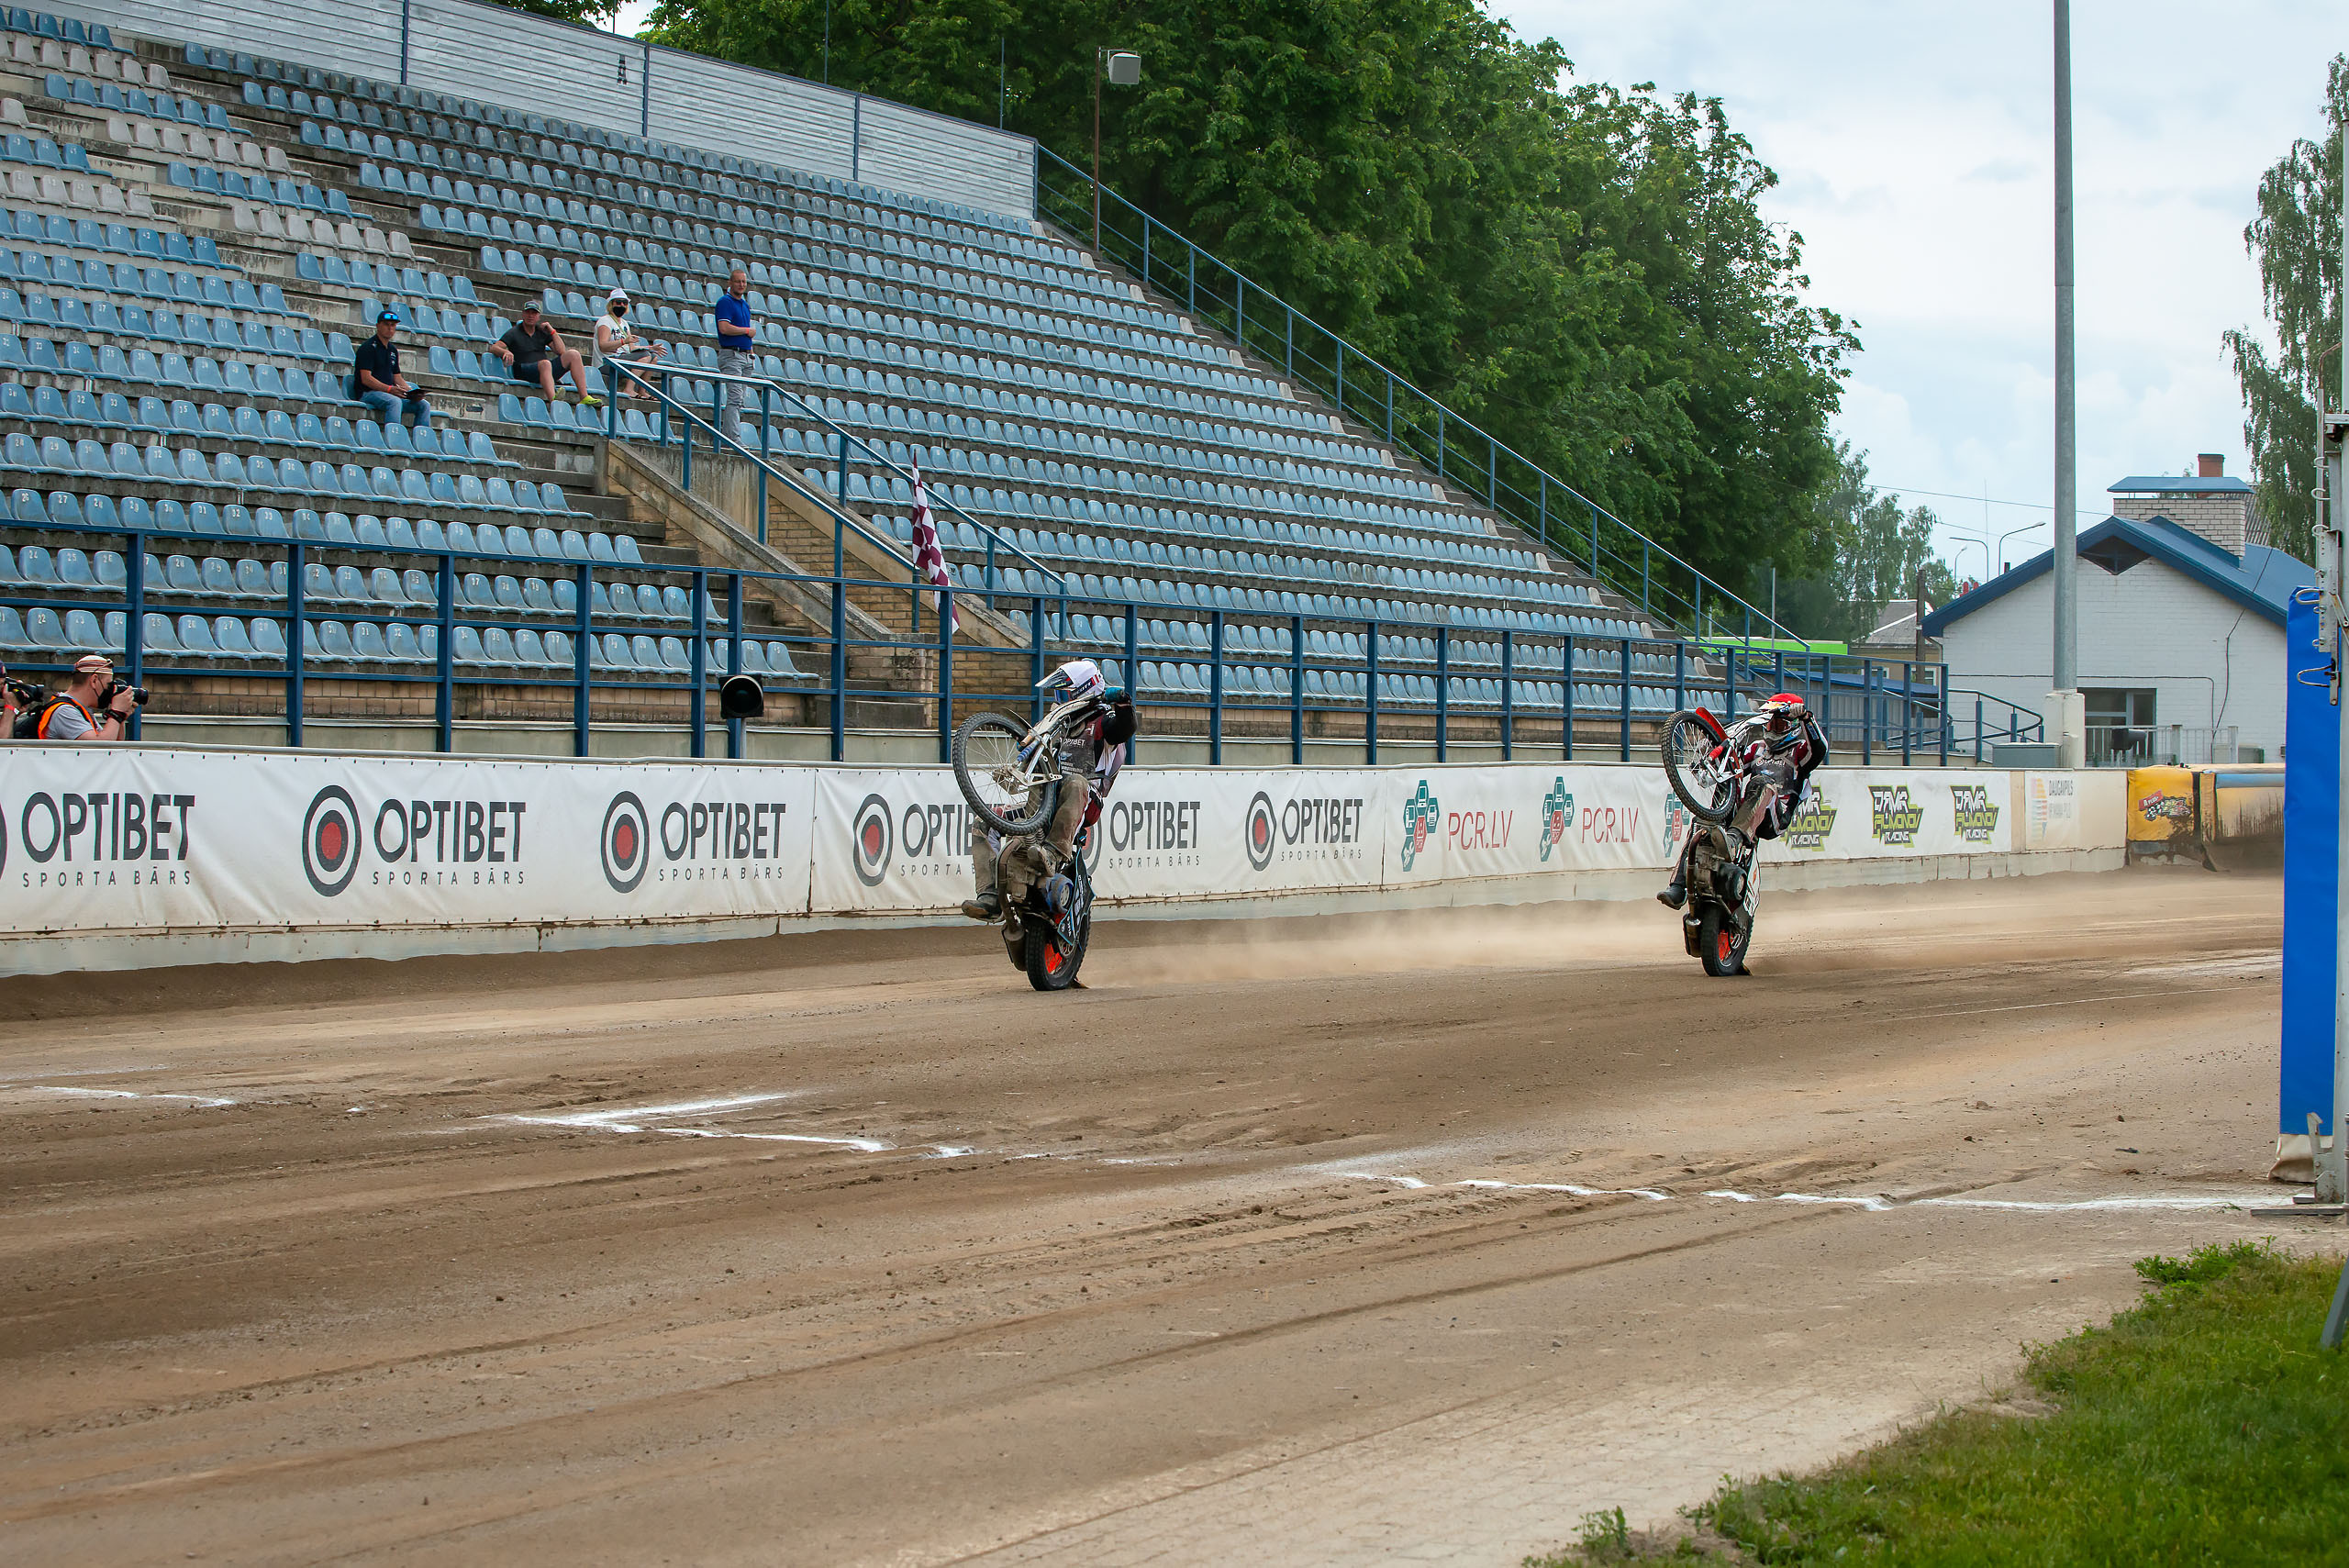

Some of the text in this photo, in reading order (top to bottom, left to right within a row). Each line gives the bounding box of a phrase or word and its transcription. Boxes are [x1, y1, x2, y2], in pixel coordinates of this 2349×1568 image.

[249, 324, 258, 333] 42
[170, 356, 178, 365] 37
[77, 395, 85, 404] 32
[153, 450, 162, 458] 32
[59, 495, 68, 504] 27
[198, 505, 206, 514] 31
[232, 508, 240, 517] 32
[264, 510, 273, 519] 33
[29, 550, 38, 559] 24
[67, 553, 77, 562] 25
[38, 615, 46, 624] 22
[22, 792, 195, 863] OPTIBET
[1109, 801, 1201, 851] OPTIBET
[1282, 798, 1364, 845] OPTIBET
[1581, 806, 1639, 844] PCR.LV
[373, 798, 527, 863] OPTIBET
[661, 802, 786, 861] OPTIBET
[1448, 810, 1513, 851] PCR.LV
[1109, 852, 1200, 869] SPORTA BĀRS
[1281, 850, 1326, 862] SPORTA
[659, 864, 783, 881] SPORTA BĀRS
[901, 863, 962, 876] SPORTA
[23, 866, 191, 888] SPORTA BĀRS
[373, 868, 524, 885] SPORTA BĀRS
